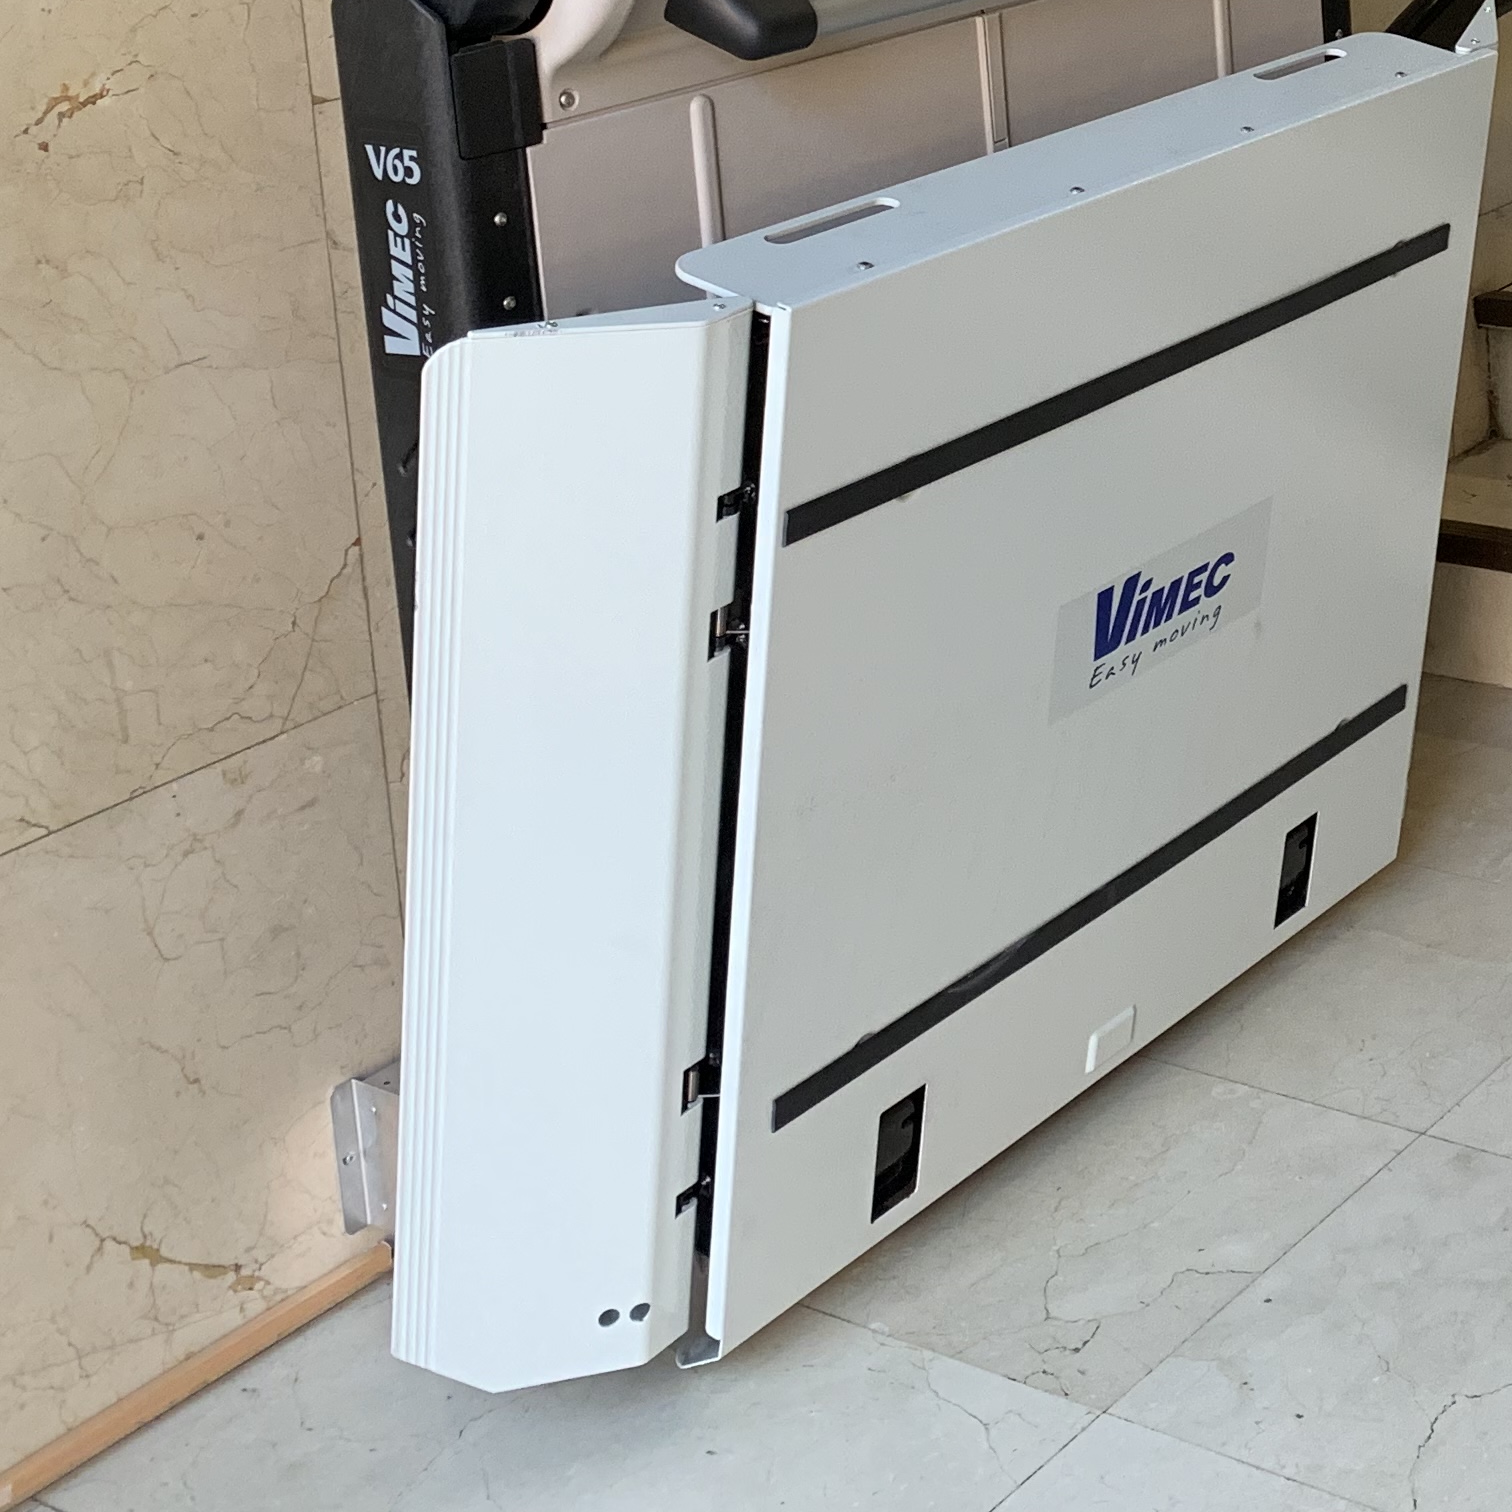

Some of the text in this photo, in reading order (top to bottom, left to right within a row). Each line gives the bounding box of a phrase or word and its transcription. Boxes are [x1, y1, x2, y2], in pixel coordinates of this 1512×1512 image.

[364, 144, 421, 185] V65
[411, 212, 436, 358] Easy moving
[1089, 604, 1222, 689] Easy moving
